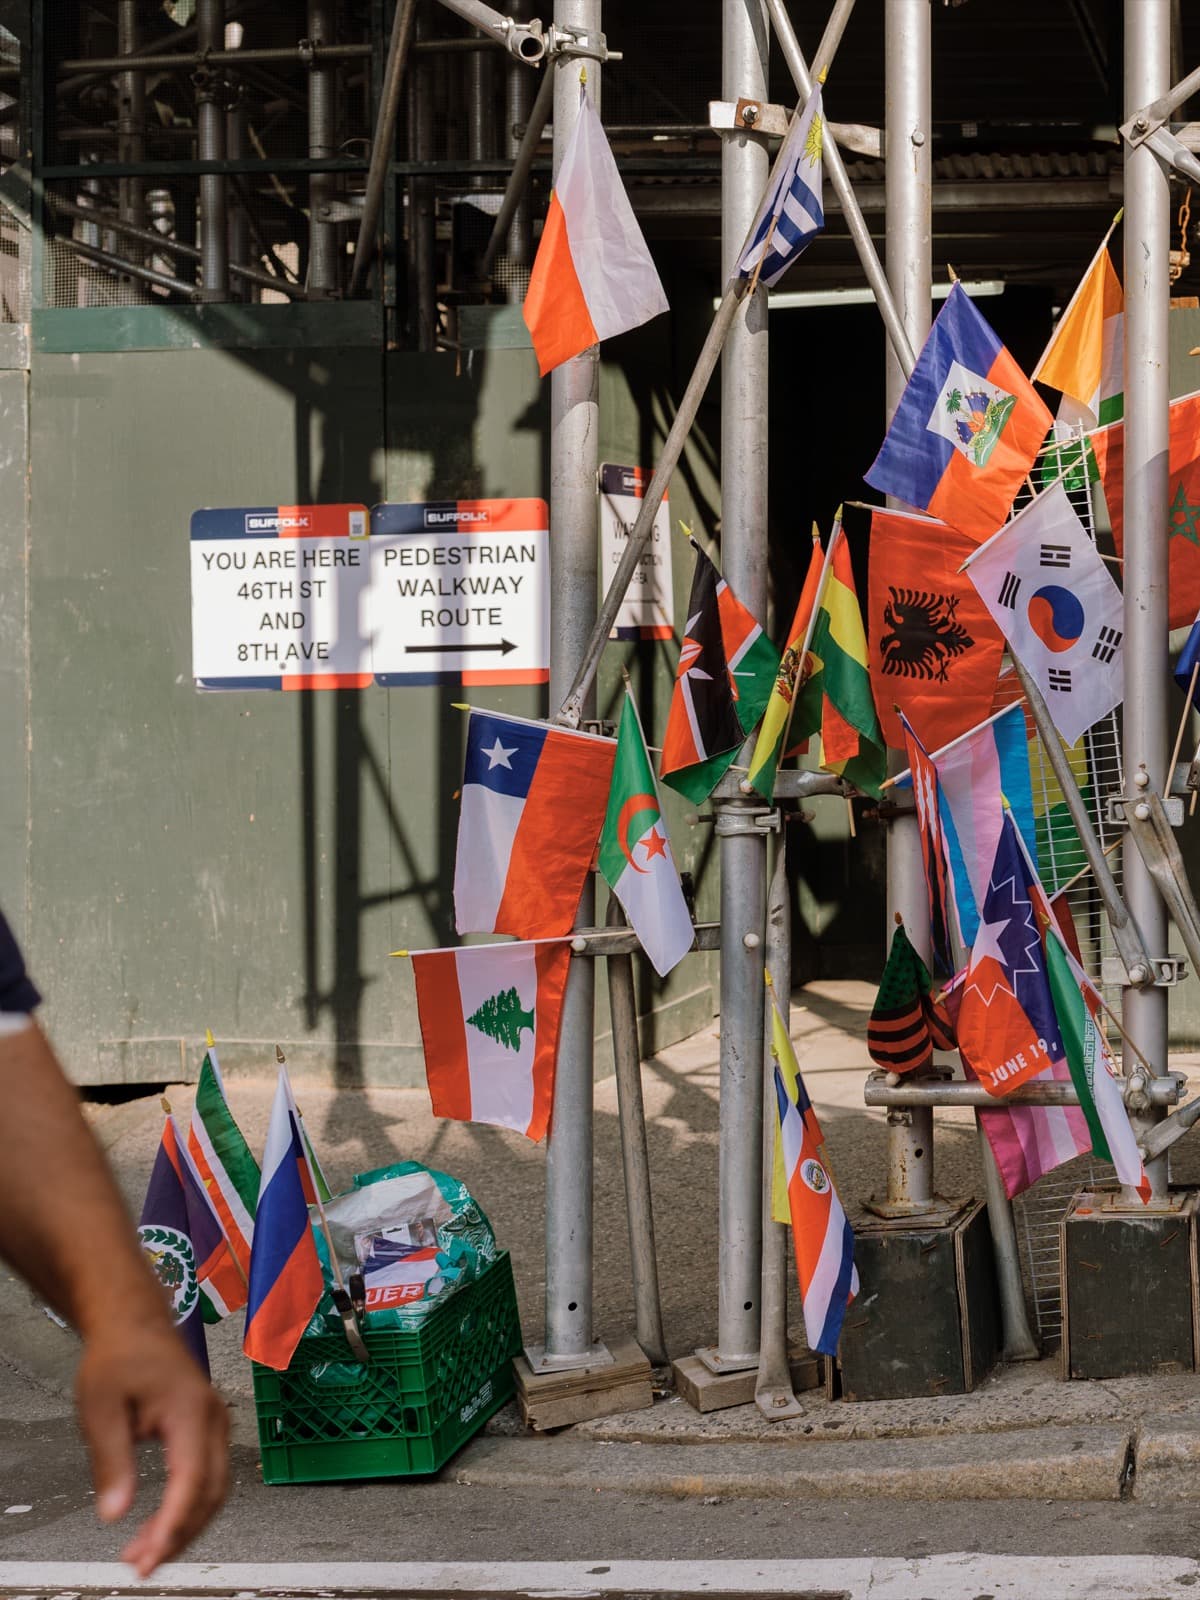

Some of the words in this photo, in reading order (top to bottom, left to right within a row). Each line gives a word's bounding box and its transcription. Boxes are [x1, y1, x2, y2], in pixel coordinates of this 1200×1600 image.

[249, 517, 309, 529] SUFFOLK
[427, 511, 488, 523] SUFFOLK
[202, 552, 247, 571] YOU
[253, 550, 297, 570] ARE
[303, 548, 361, 568] HERE
[384, 544, 536, 567] PEDESTRIAN
[237, 581, 293, 600] 46TH
[300, 580, 327, 599] ST
[397, 576, 524, 597] WALKWAY
[259, 612, 306, 631] AND
[421, 607, 503, 628] ROUTE
[237, 642, 279, 662] 8TH
[285, 642, 330, 661] AVE
[989, 1052, 1028, 1087] JUNE
